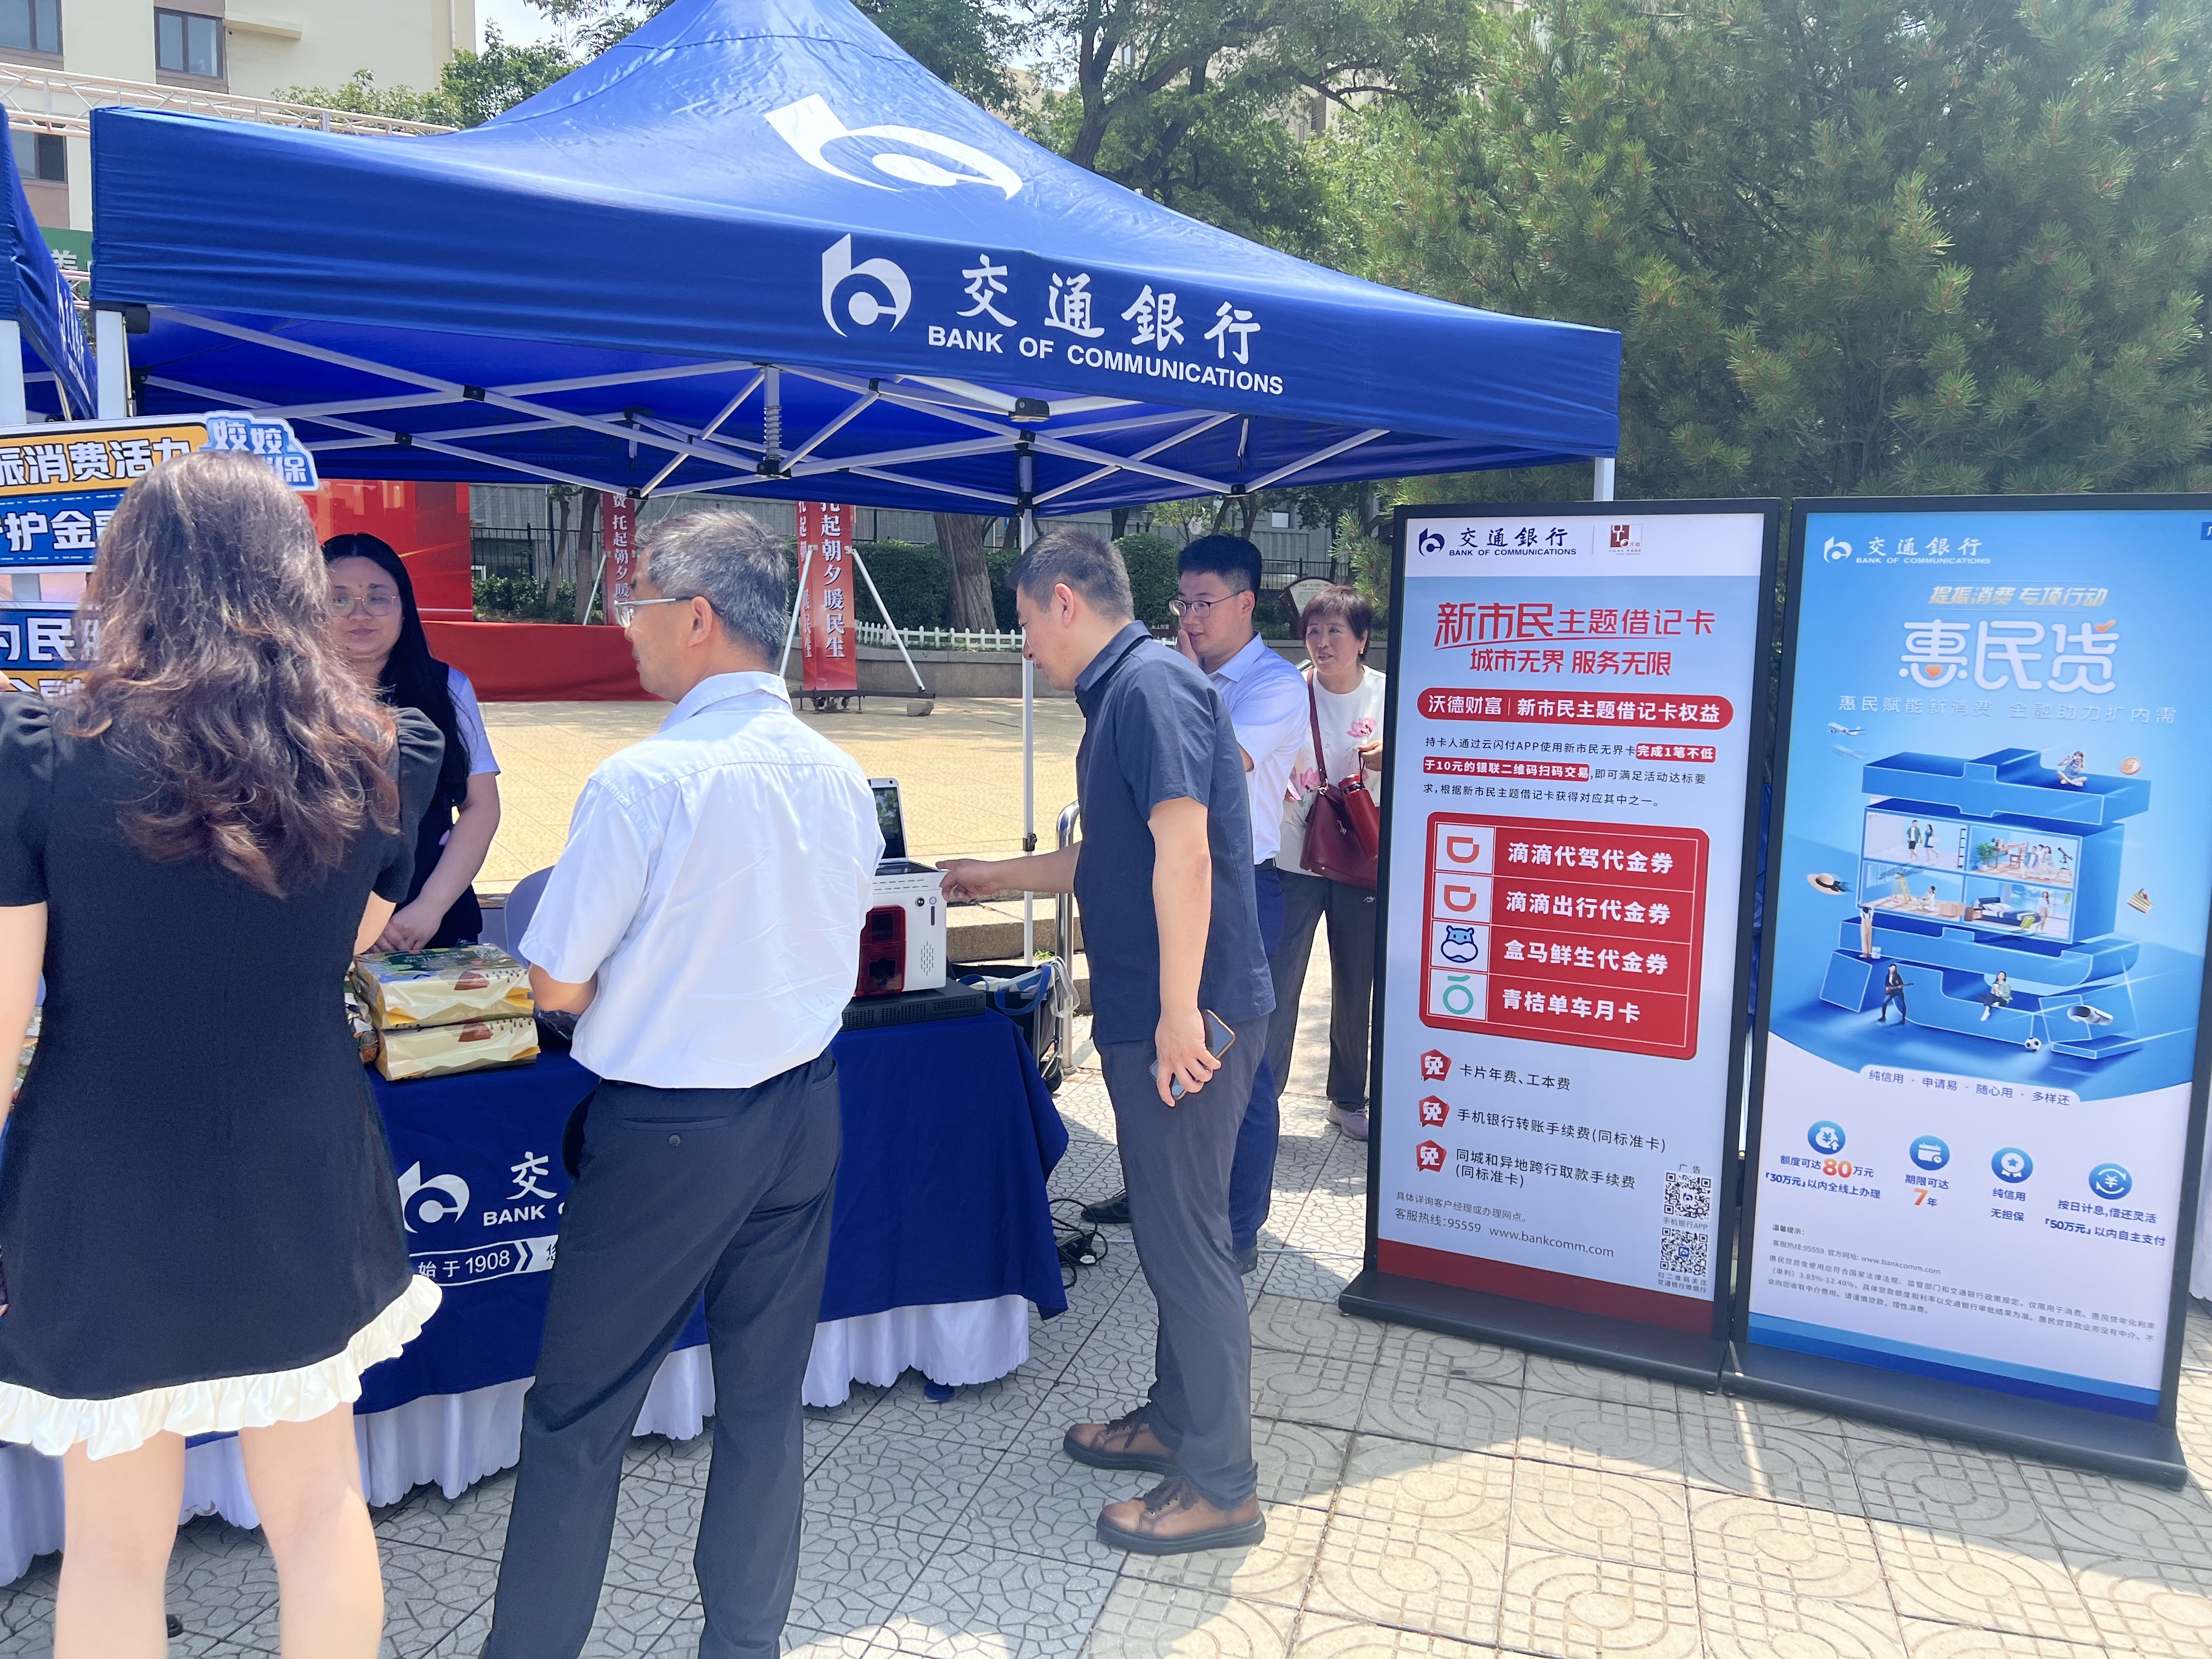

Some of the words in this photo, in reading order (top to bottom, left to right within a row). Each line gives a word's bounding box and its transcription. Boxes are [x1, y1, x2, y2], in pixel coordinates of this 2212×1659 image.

[957, 253, 1261, 364] 交通銀行
[928, 325, 1003, 354] BANK
[1019, 336, 1054, 358] OF
[1068, 345, 1283, 395] COMMUNICATIONS
[1459, 527, 1568, 547] 交通銀行
[1866, 537, 1983, 556] 交通銀行
[1928, 586, 2016, 606] 提振消费
[2018, 587, 2109, 607] 专项行动
[1434, 602, 1716, 647] 新市民主题借记卡
[1470, 648, 1565, 673] 城市无界
[1571, 650, 1671, 676] 服务无限
[1428, 696, 1503, 715] 沃德财富
[1517, 698, 1720, 723] 新市民主题借记卡权益
[1838, 695, 1993, 717] 惠民赋能新消费
[1508, 842, 1673, 874] 滴滴代驾代金券
[1505, 890, 1671, 925] 滴滴出行代金券
[1504, 939, 1668, 975] 盒马鲜生代金券
[1502, 989, 1640, 1024] 青桔单车月卡
[1424, 1055, 1444, 1075] 免
[1459, 1064, 1571, 1091] 卡片年费、工本费
[1869, 1070, 1904, 1084] 纯信用
[1922, 1077, 1957, 1091] 申请易
[1976, 1084, 2013, 1098] 随心用
[2032, 1091, 2070, 1106] 多样还
[1423, 1101, 1443, 1121] 免
[506, 1151, 557, 1200] 交
[1420, 1146, 1440, 1166] 免
[1456, 1148, 1636, 1189] 同城和异地跨行取款手续费
[1905, 1174, 1949, 1189] 期限可达
[1914, 1187, 1938, 1207] 7年
[1992, 1188, 2025, 1201] 纯信用
[483, 1205, 546, 1227] BANK
[1990, 1208, 2024, 1222] 无担保
[1489, 1227, 1614, 1257] www.bankcomm.com
[1860, 1255, 1941, 1275] www.bankcomm.com
